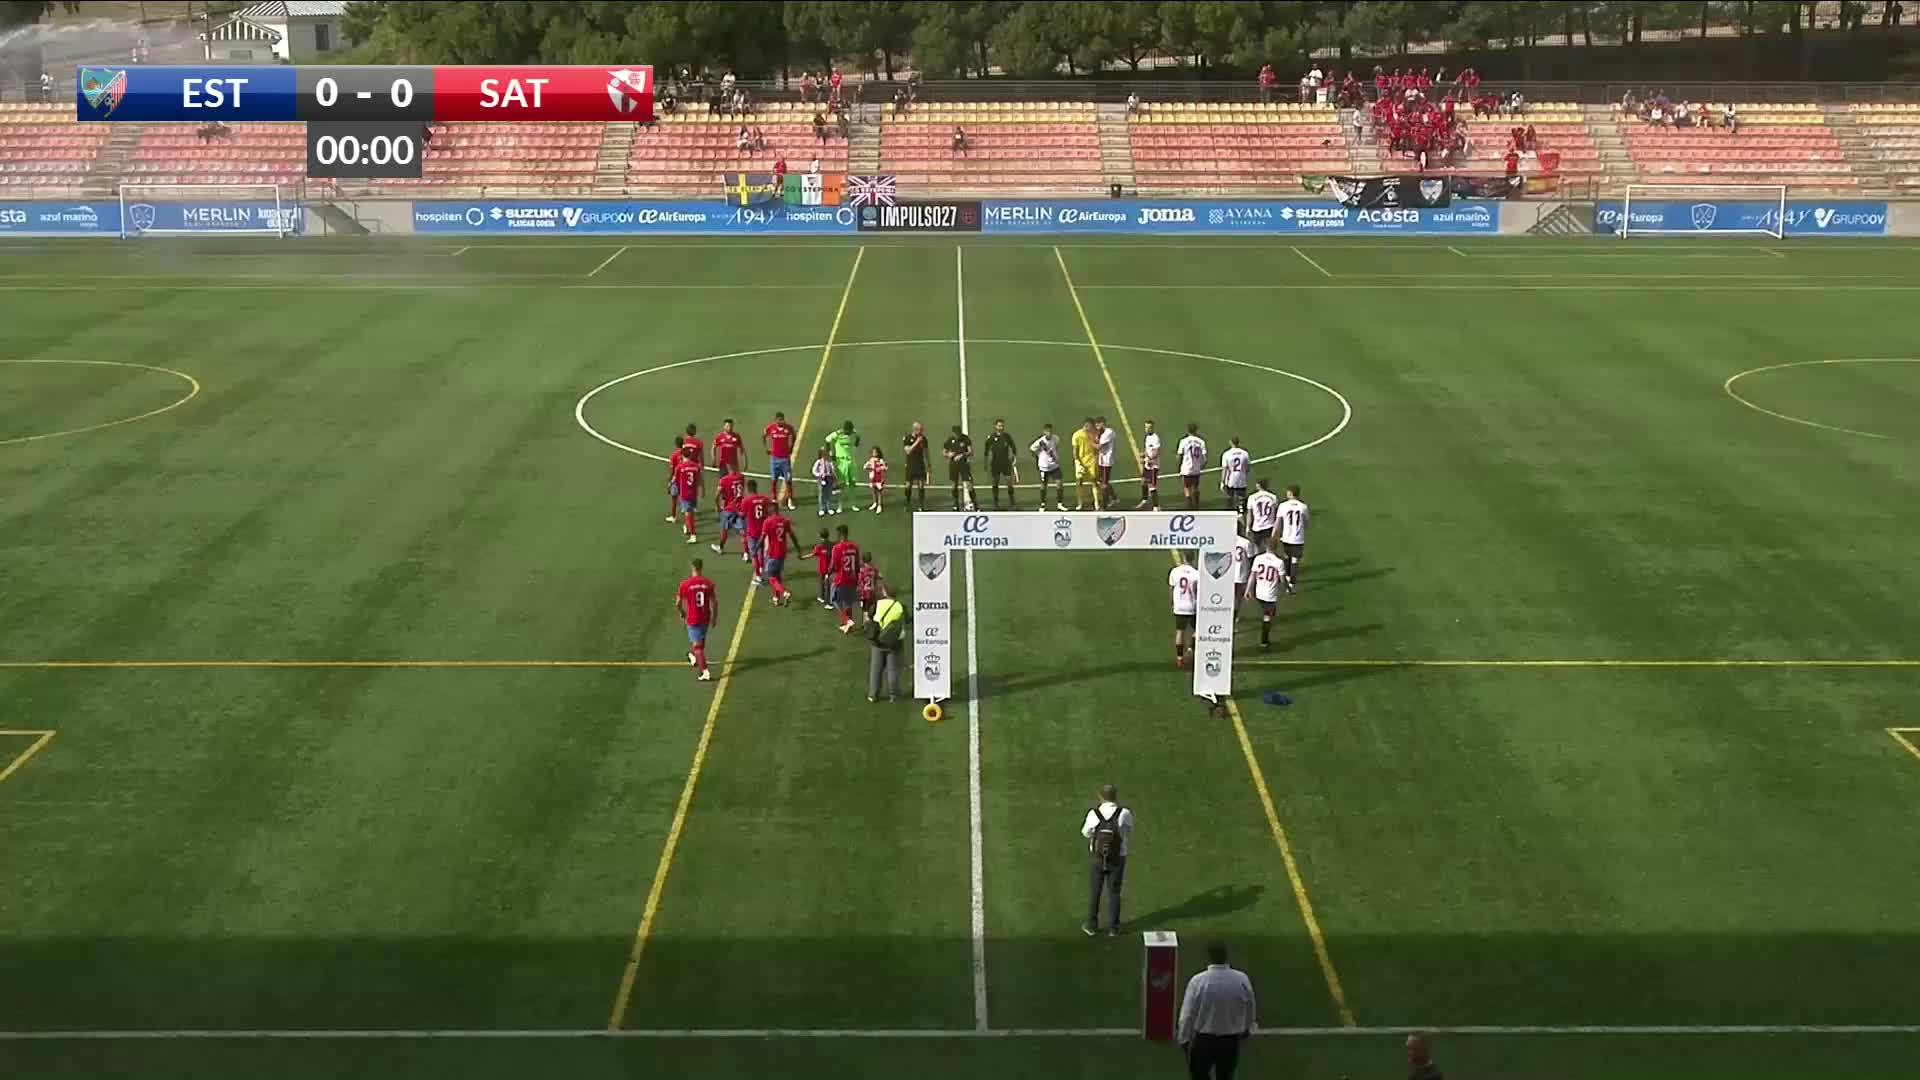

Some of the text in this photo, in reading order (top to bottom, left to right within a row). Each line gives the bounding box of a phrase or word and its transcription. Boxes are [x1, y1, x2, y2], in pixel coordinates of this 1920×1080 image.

[40, 212, 98, 222] azul marino
[183, 207, 251, 221] MERLIN
[415, 211, 463, 223] hospiten
[505, 207, 559, 219] SUZUKI
[658, 211, 707, 223] AirEuropa
[786, 210, 833, 223] hospiten
[880, 206, 957, 227] IMPULSO27
[985, 206, 1053, 220] MERLIN
[1078, 211, 1127, 223] AirEuropa
[1225, 208, 1273, 219] AYANA
[1295, 208, 1349, 219] SUZUKI
[1356, 207, 1420, 223] Acosta
[1432, 211, 1490, 222] azul marino
[1616, 213, 1664, 223] AEuropa
[1233, 458, 1241, 472] 2
[687, 471, 694, 486] 3
[755, 505, 763, 519] 6
[1256, 502, 1271, 518] 16
[1286, 510, 1301, 527] 11
[943, 535, 1009, 548] AirEuropa
[1149, 534, 1216, 547] AirEuropa
[844, 555, 856, 571] 21
[1258, 563, 1277, 582] 20
[1180, 577, 1189, 594] 9
[696, 591, 704, 607] 9
